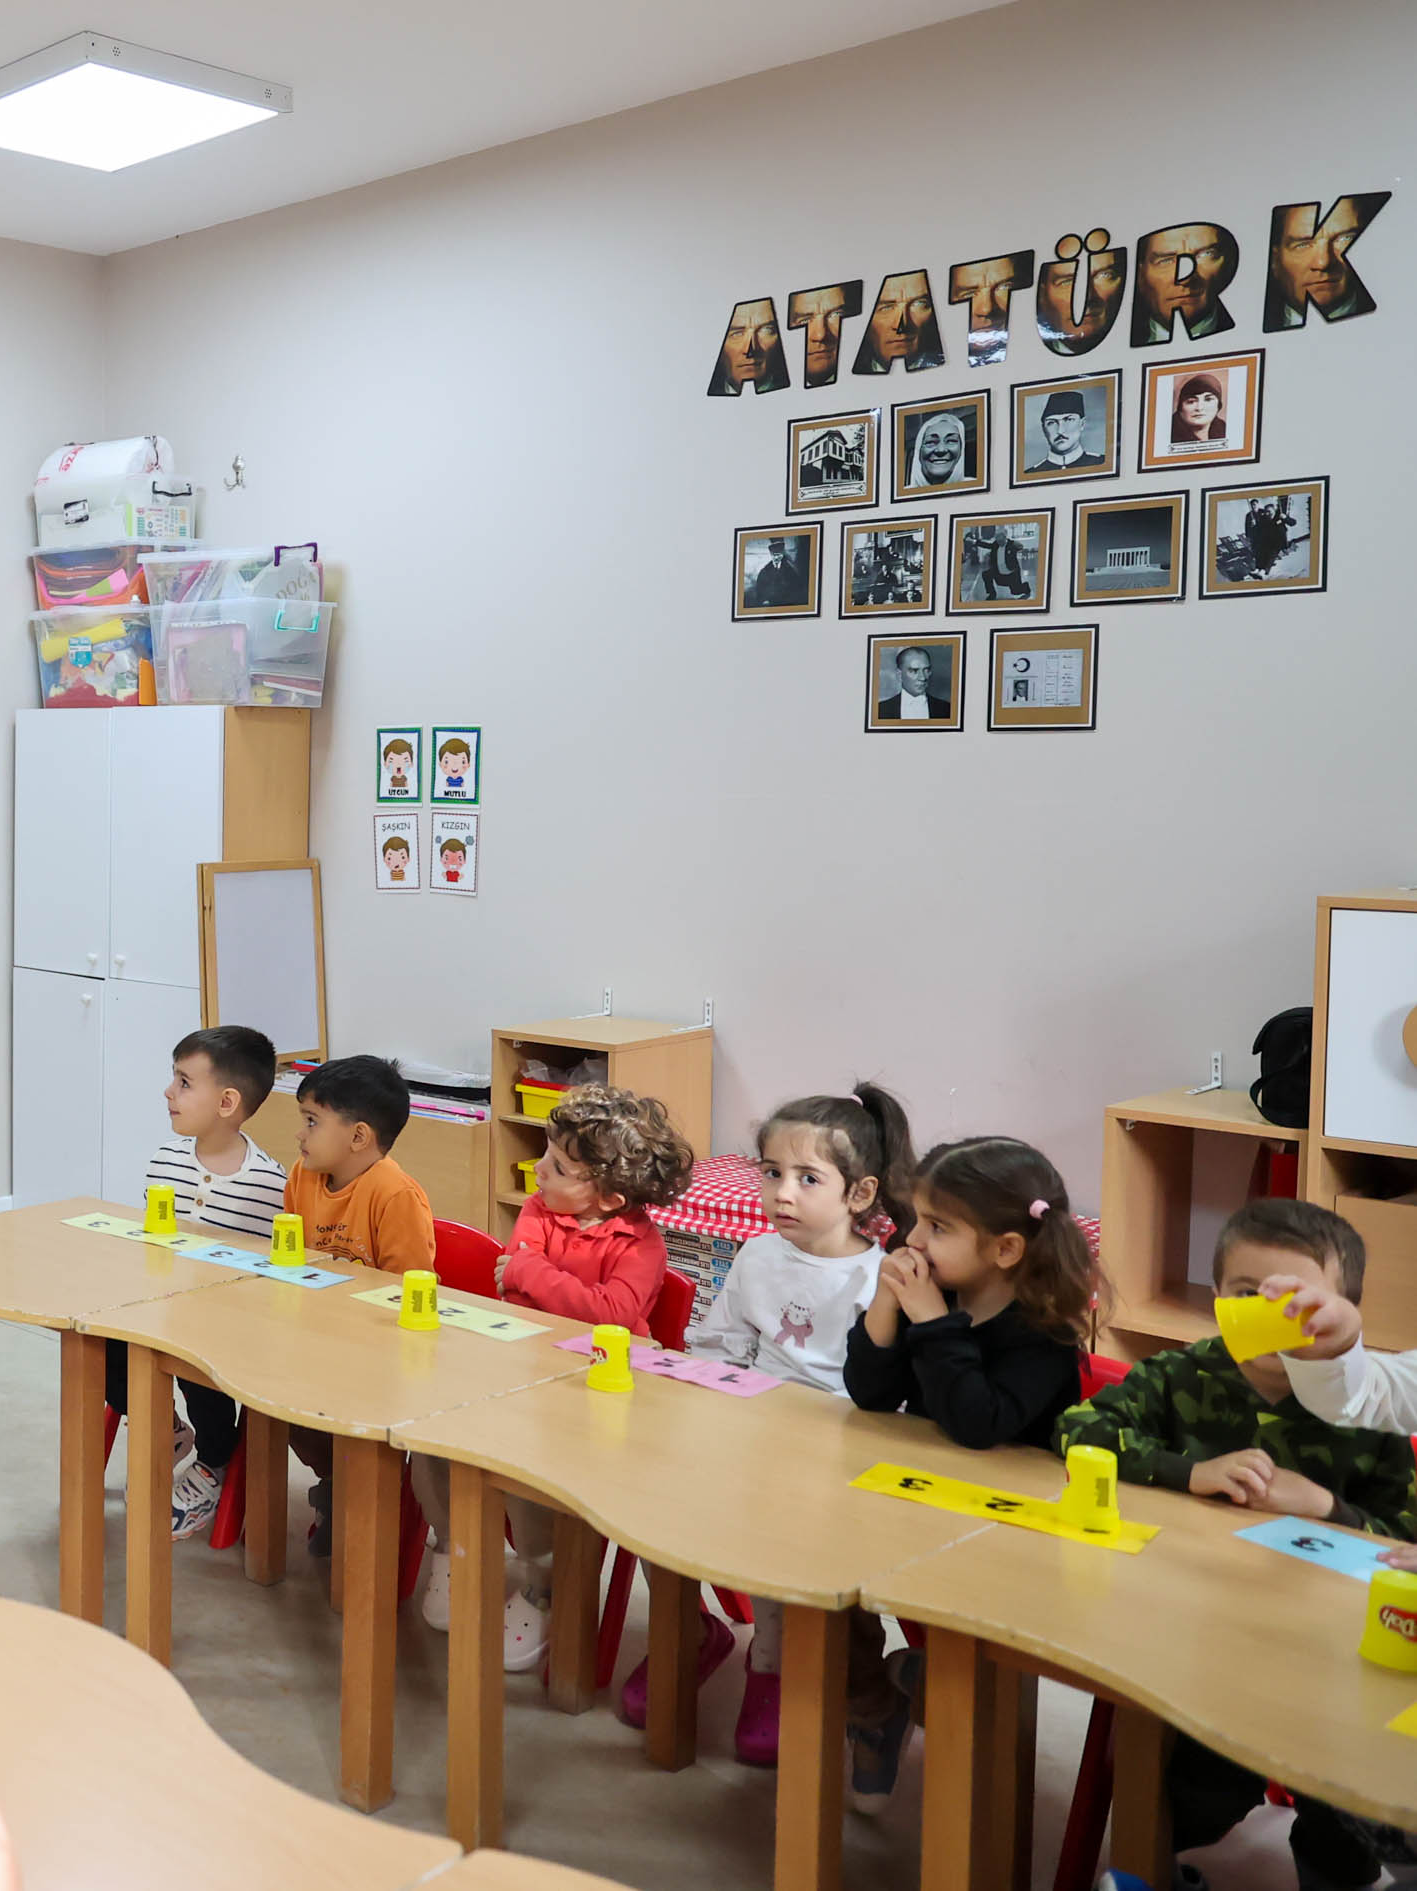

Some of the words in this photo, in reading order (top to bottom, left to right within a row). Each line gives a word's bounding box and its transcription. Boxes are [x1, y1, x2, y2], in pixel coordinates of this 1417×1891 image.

[706, 190, 1394, 397] ATATÜRK
[443, 790, 467, 798] MUTLU
[381, 821, 411, 833] ŞAŞKIN
[441, 821, 470, 831] KIZGIN
[438, 1307, 466, 1317] 2
[898, 1477, 933, 1491] 3
[985, 1497, 1024, 1512] 2
[1290, 1536, 1335, 1552] 3
